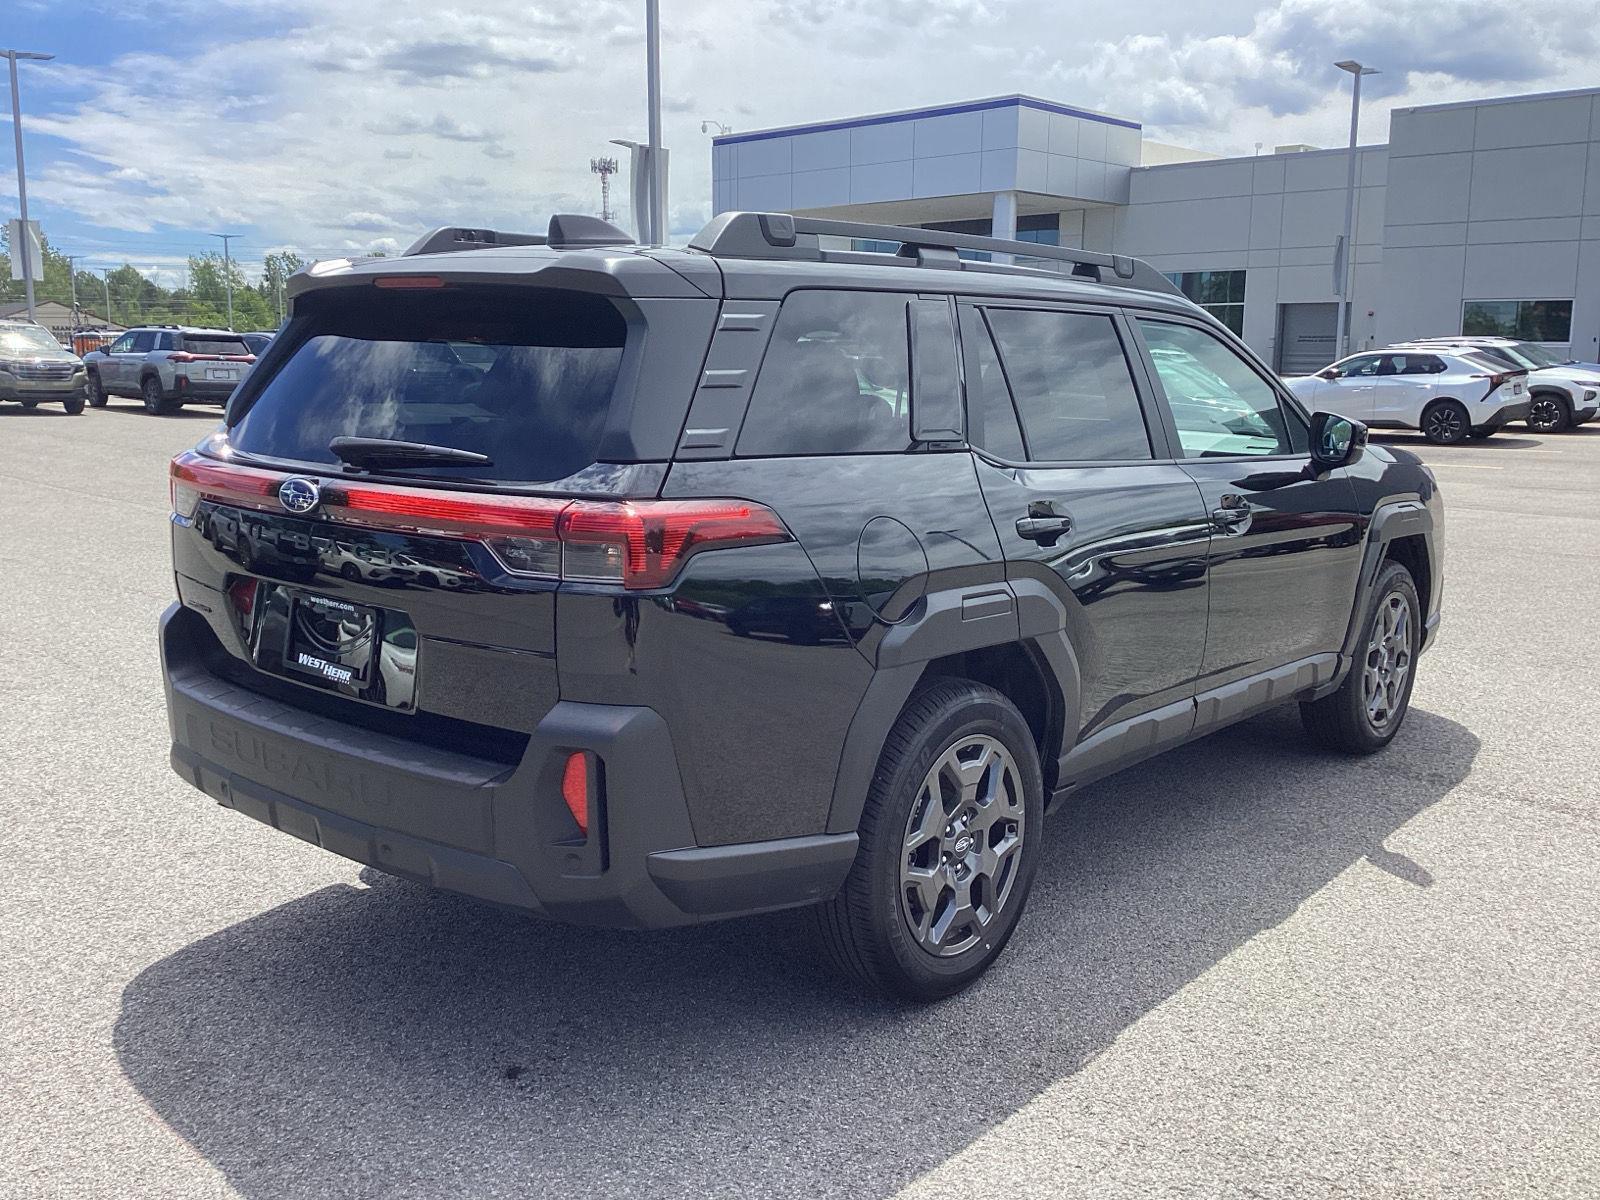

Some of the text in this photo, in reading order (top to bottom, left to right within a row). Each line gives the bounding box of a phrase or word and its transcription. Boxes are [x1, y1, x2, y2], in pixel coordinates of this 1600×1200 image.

[310, 596, 354, 611] westherr.com
[298, 653, 351, 680] WEST HERR
[209, 721, 391, 806] SUBARU
